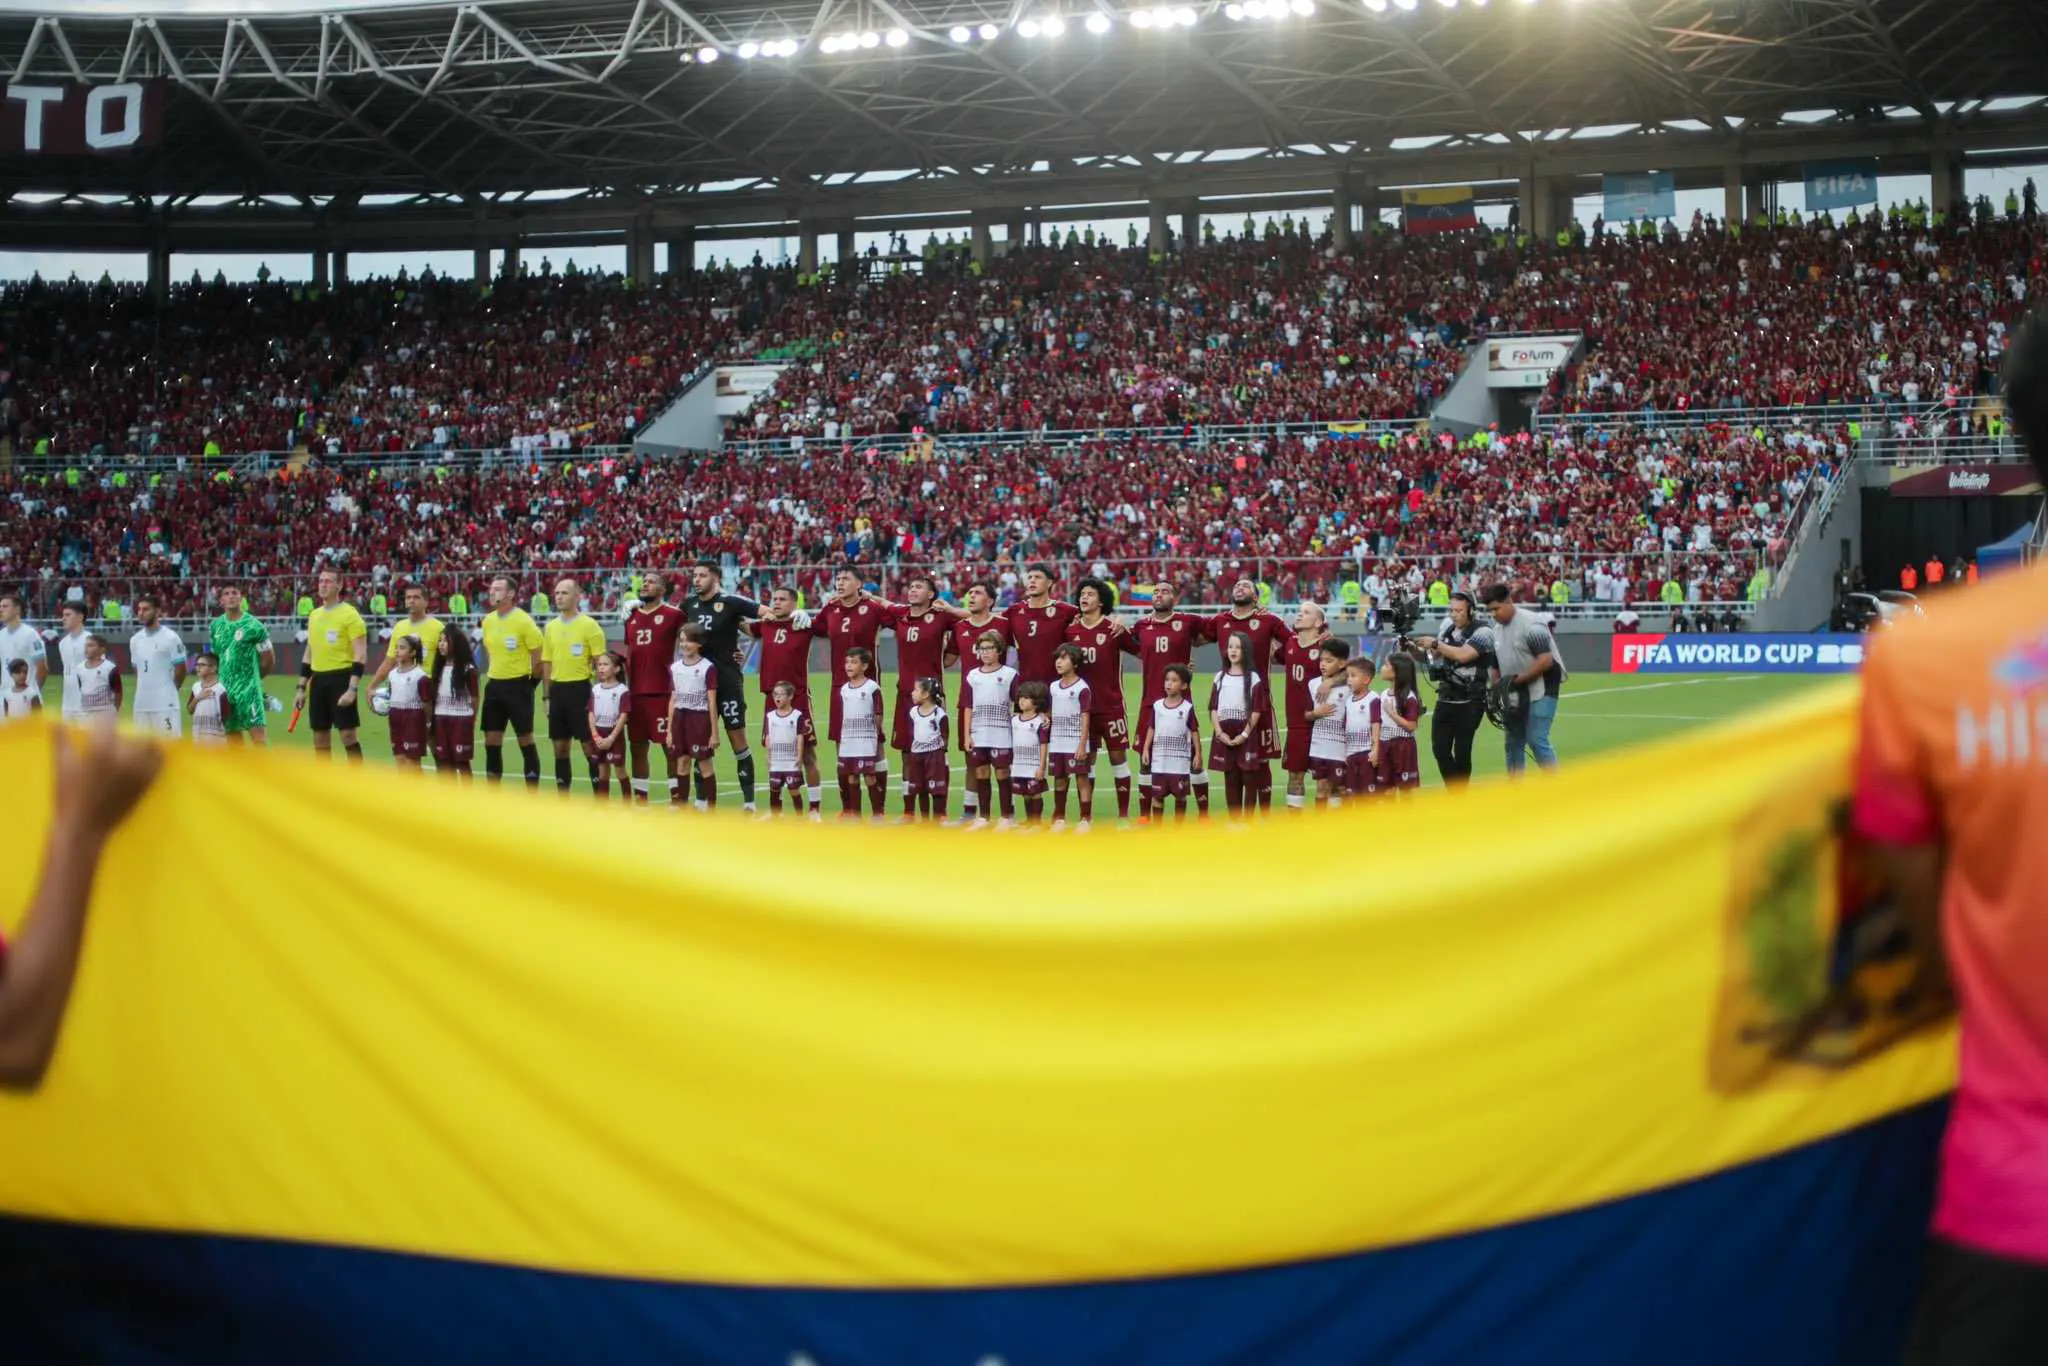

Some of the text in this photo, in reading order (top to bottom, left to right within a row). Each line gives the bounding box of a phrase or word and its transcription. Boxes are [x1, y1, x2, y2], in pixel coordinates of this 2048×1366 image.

[6, 82, 143, 150] TO
[1815, 173, 1867, 196] FIFA
[698, 615, 713, 630] 22
[841, 617, 850, 632] 2
[1028, 620, 1038, 637] 3
[636, 629, 652, 645] 23
[774, 628, 788, 644] 15
[906, 626, 920, 642] 16
[1155, 636, 1168, 653] 18
[1081, 647, 1096, 664] 20
[1623, 645, 1672, 663] FIFA
[1676, 644, 1761, 663] WORLD
[1765, 644, 1812, 663] CUP
[1292, 664, 1305, 682] 10
[722, 700, 739, 717] 22
[164, 717, 172, 730] 3
[1108, 718, 1126, 737] 20
[1261, 729, 1273, 746] 13
[1955, 700, 2048, 770] HI
